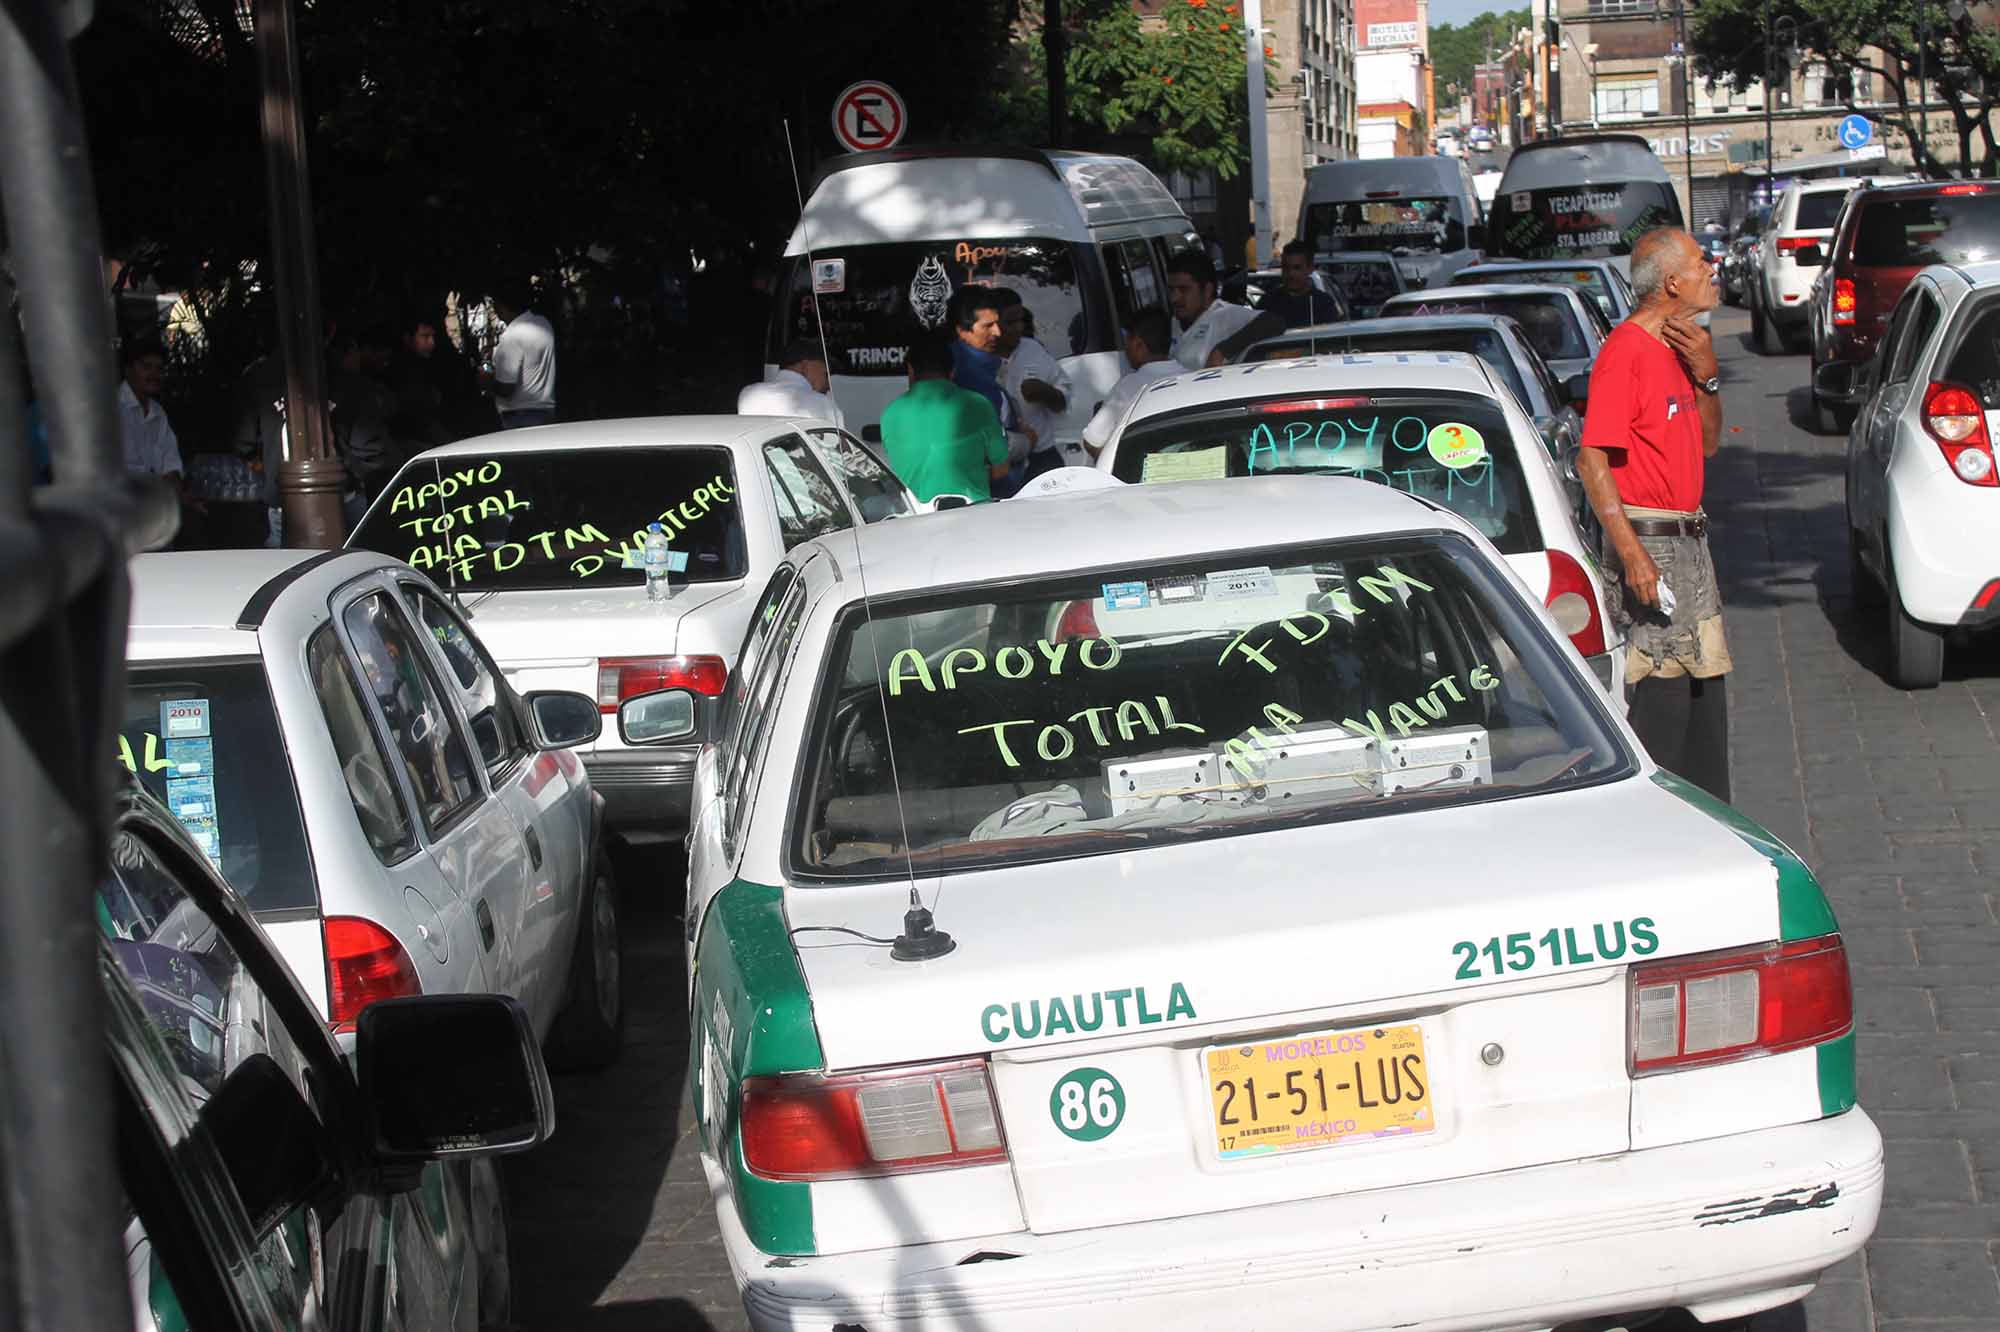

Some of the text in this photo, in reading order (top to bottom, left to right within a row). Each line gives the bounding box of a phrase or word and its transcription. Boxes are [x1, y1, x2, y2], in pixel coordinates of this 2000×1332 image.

[1579, 231, 1621, 247] BARBARA
[1247, 415, 1430, 478] APOYO
[1445, 426, 1465, 449] 3
[390, 461, 502, 515] APOYO
[399, 489, 530, 538] TOTAL
[1227, 581, 1258, 591] 2011
[888, 635, 1123, 696] APOYO
[170, 707, 202, 718] 2010
[957, 696, 1206, 768] TOTAL
[1452, 916, 1661, 981] 2151LUS
[981, 982, 1197, 1044] CUAUTLA
[1264, 1034, 1367, 1063] MORELOS
[1057, 1076, 1119, 1133] 86
[1214, 1053, 1426, 1126] 21-51-LUS
[1219, 1136, 1236, 1150] 17
[1295, 1119, 1358, 1138] MÉXICO
